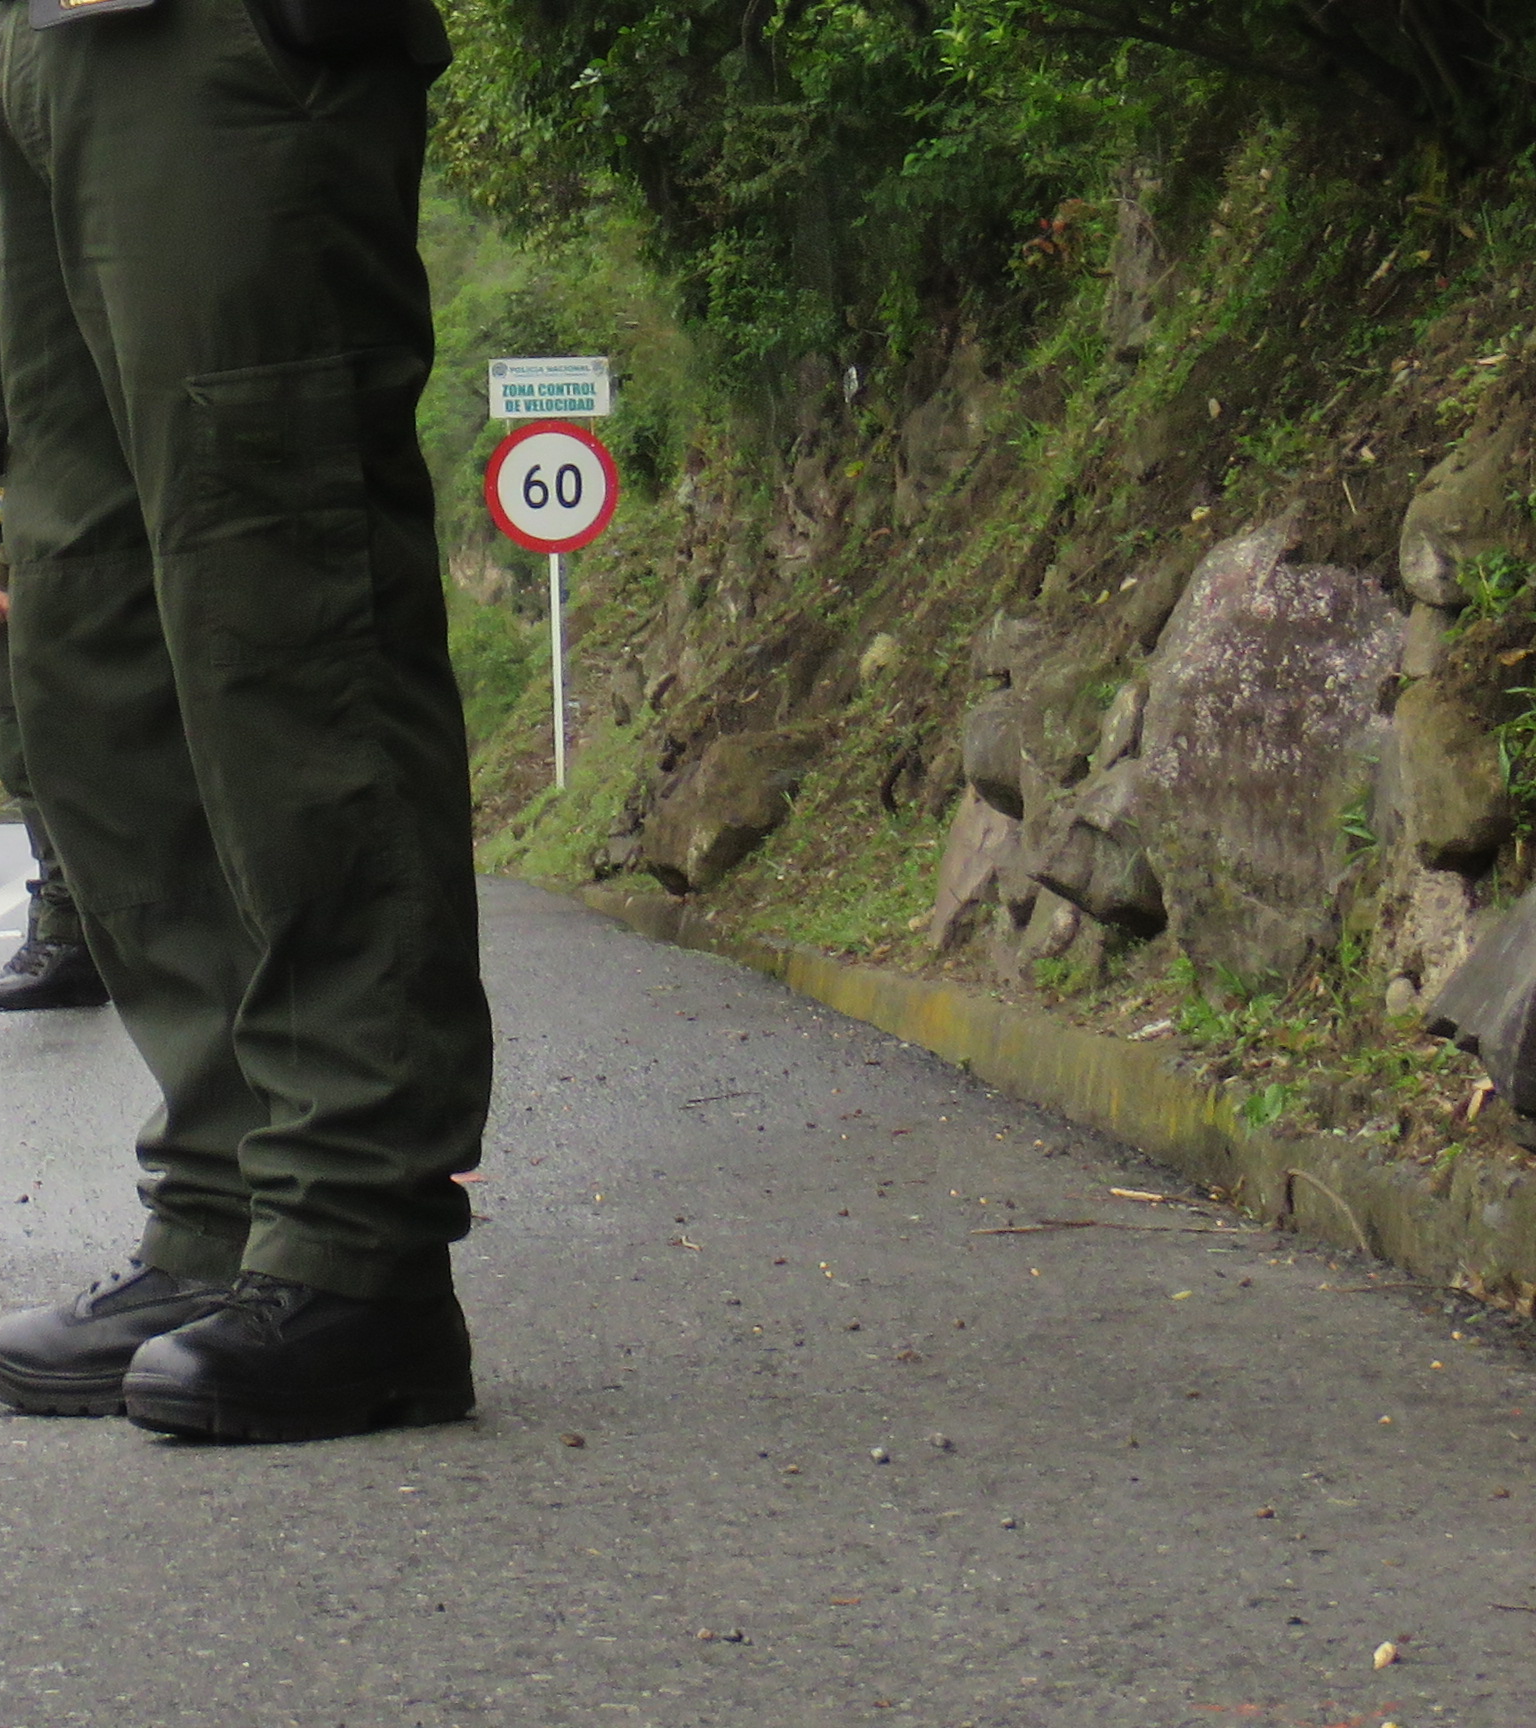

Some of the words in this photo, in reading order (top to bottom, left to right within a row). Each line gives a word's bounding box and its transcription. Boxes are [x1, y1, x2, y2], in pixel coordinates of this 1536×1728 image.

[502, 383, 534, 397] ZONA
[538, 382, 596, 396] CONTROL
[505, 399, 521, 412] DE
[524, 398, 595, 412] VELOCIDAD
[523, 463, 582, 509] 60
